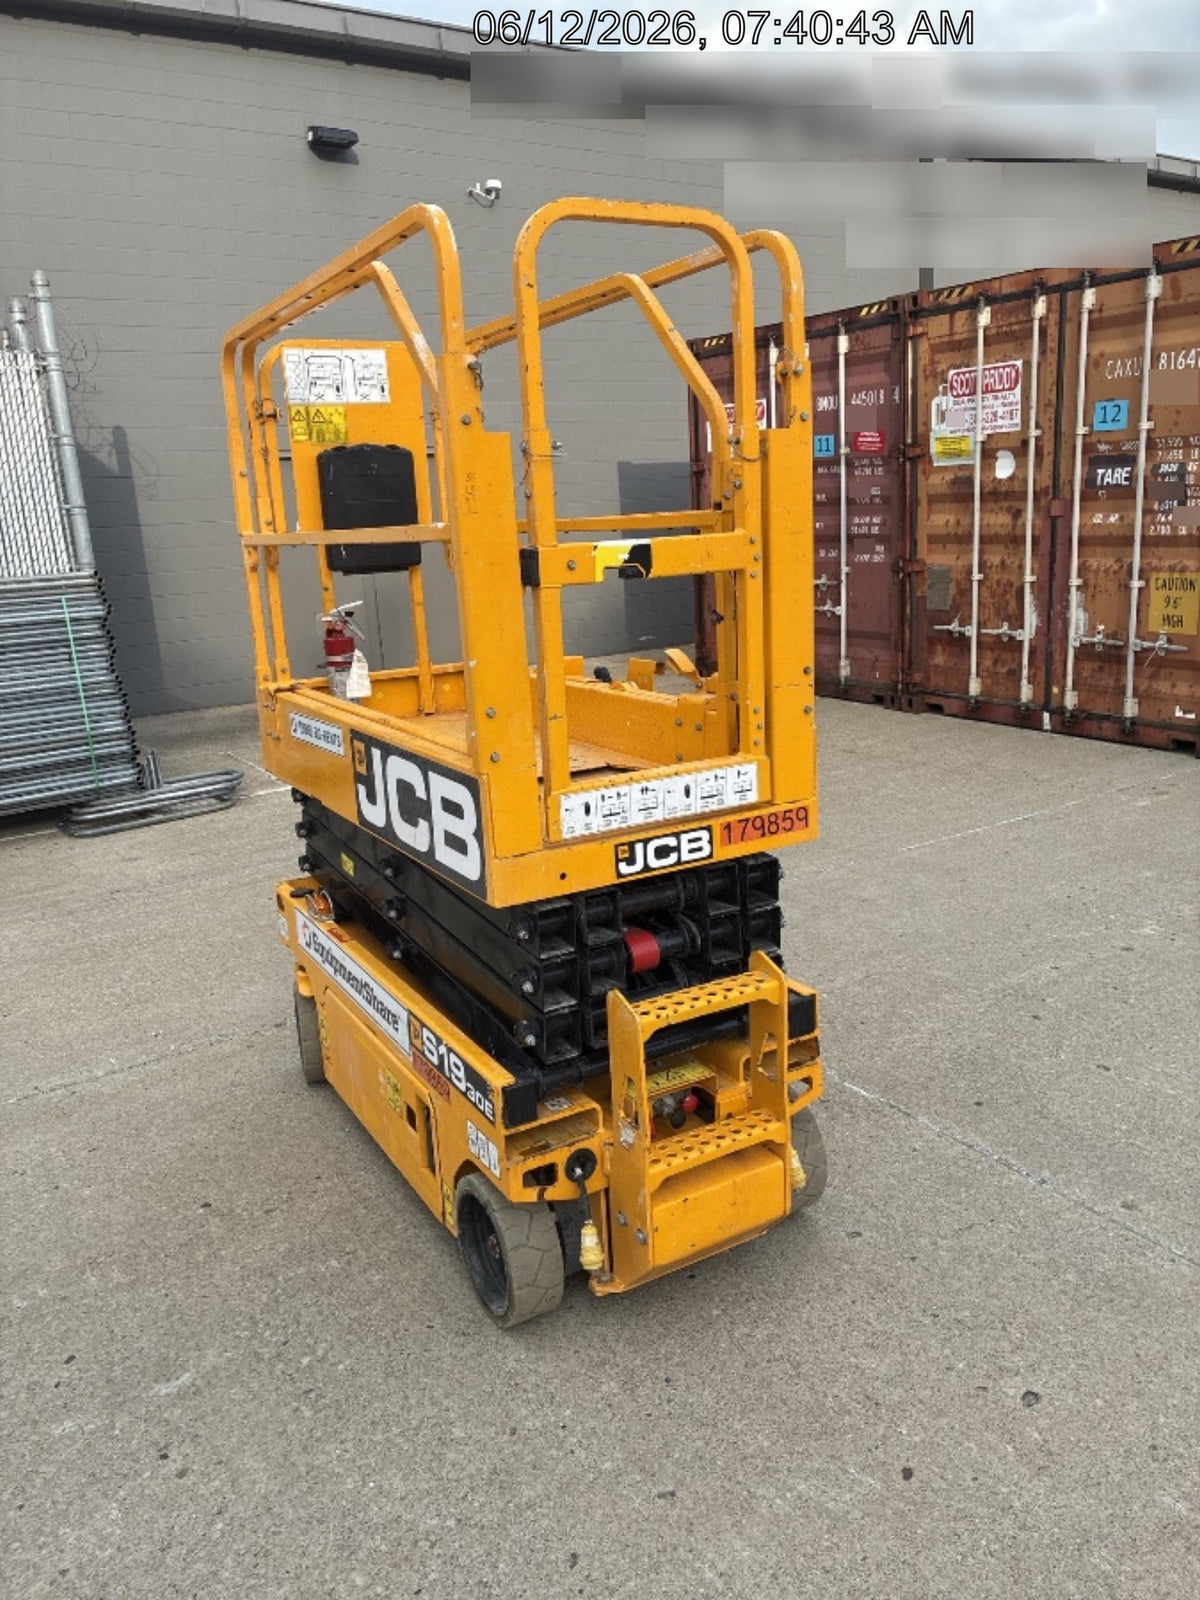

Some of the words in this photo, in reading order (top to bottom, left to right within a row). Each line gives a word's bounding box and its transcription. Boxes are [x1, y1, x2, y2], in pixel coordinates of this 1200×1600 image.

[952, 371, 978, 396] SCOT
[1098, 403, 1122, 424] 12
[816, 436, 831, 453] 11
[1096, 466, 1132, 486] TARE
[1155, 577, 1196, 592] CAUTION
[356, 745, 481, 881] JCB
[722, 806, 810, 845] 179859
[617, 829, 711, 876] JCB
